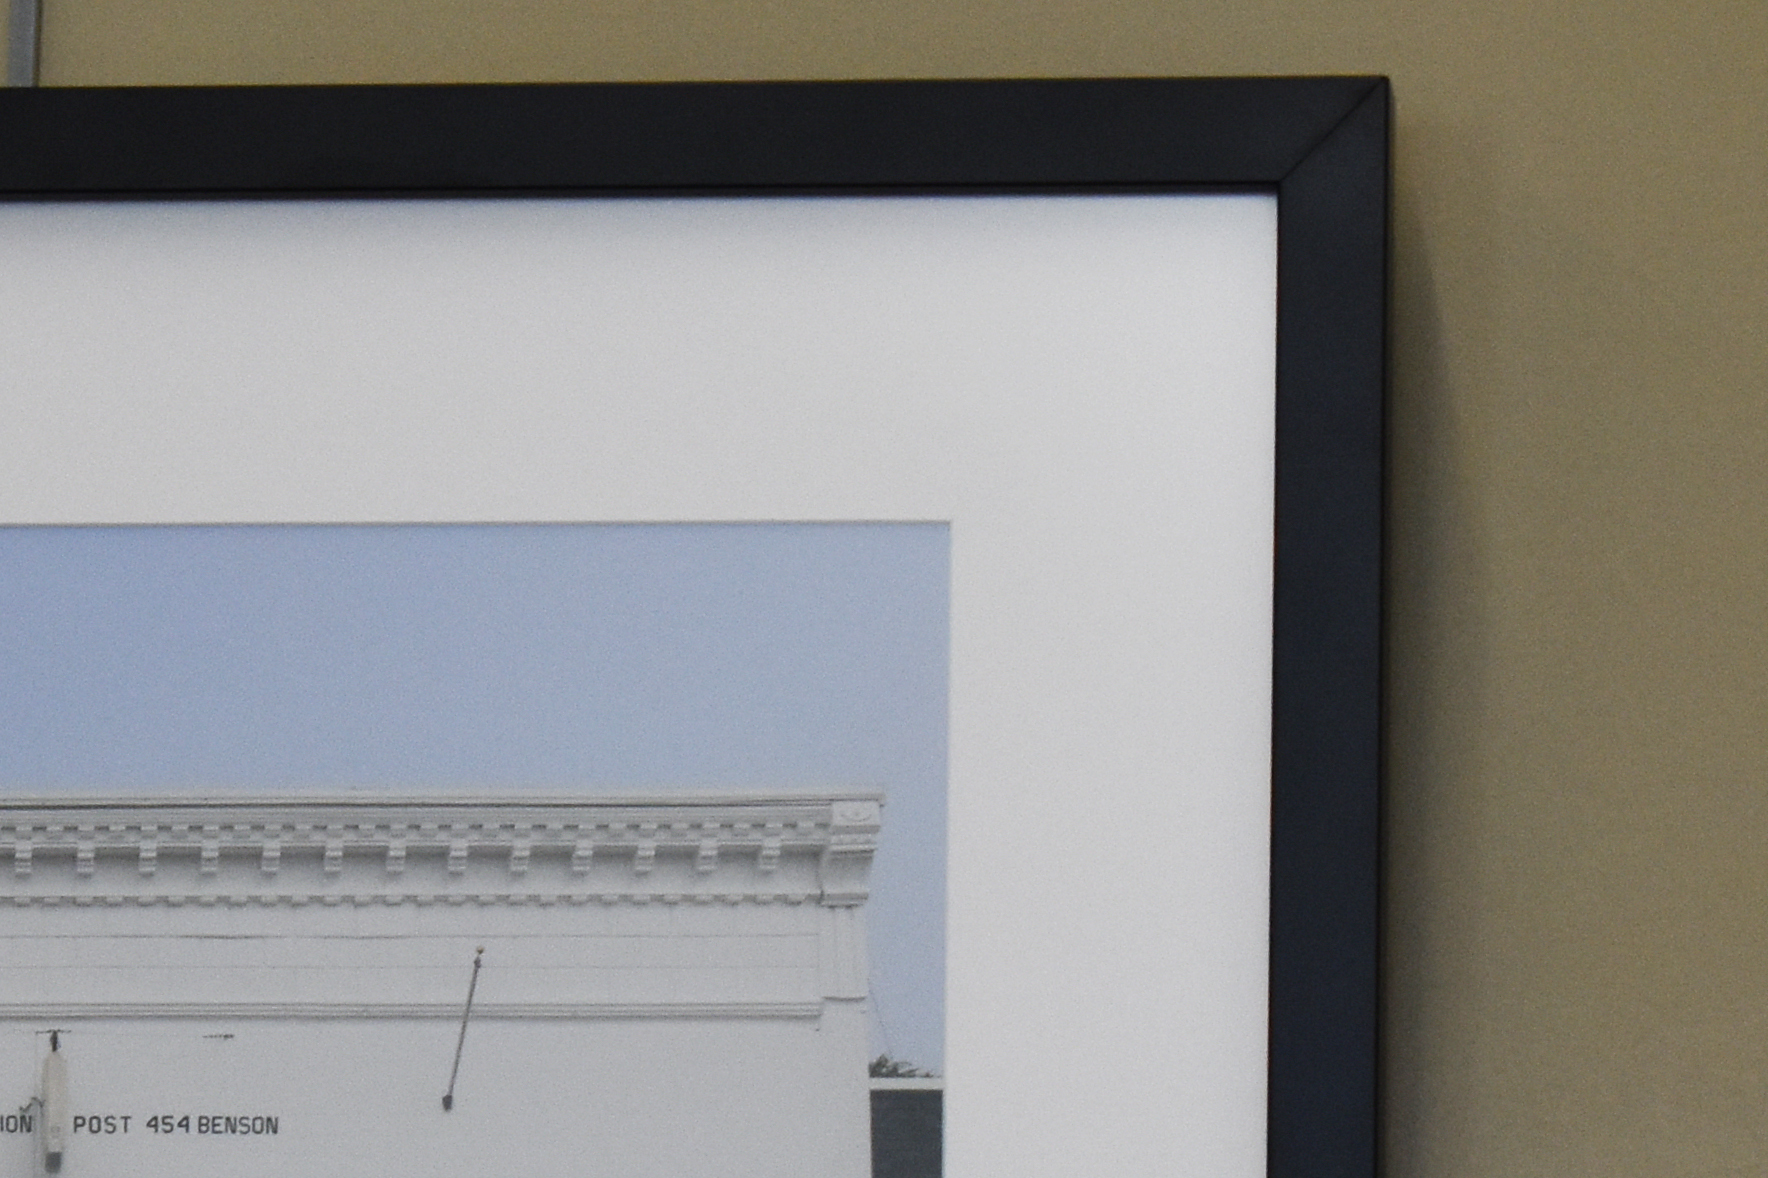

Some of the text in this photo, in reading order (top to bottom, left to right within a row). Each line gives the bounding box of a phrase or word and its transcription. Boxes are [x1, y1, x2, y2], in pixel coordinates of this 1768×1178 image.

[73, 1115, 132, 1134] POST
[145, 1114, 190, 1134] 454
[198, 1115, 279, 1135] BENSON
